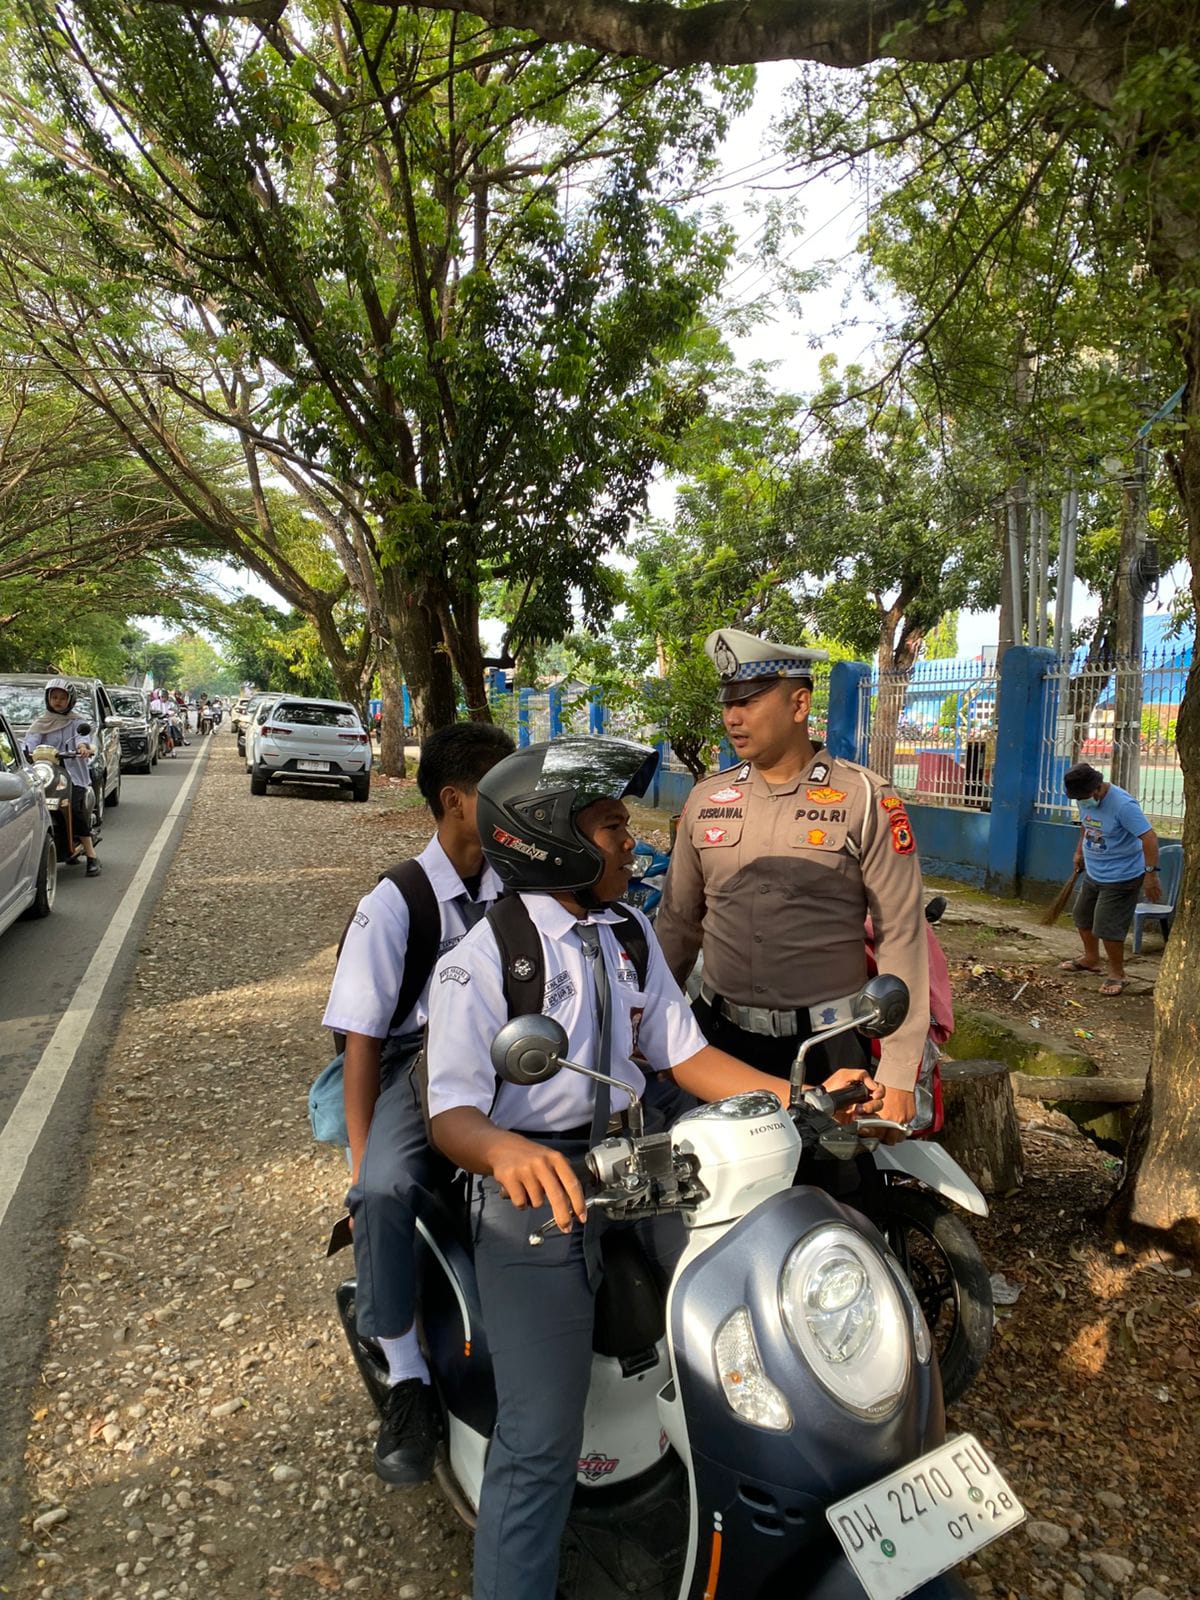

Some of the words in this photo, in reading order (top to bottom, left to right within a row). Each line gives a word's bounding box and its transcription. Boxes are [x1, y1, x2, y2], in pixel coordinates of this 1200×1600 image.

[698, 807, 743, 819] JUSRIAWAL
[795, 809, 846, 823] POLRI
[749, 1122, 786, 1136] HONDA
[837, 1504, 883, 1553] DW
[887, 1467, 952, 1524] 2270
[951, 1445, 990, 1489] FU
